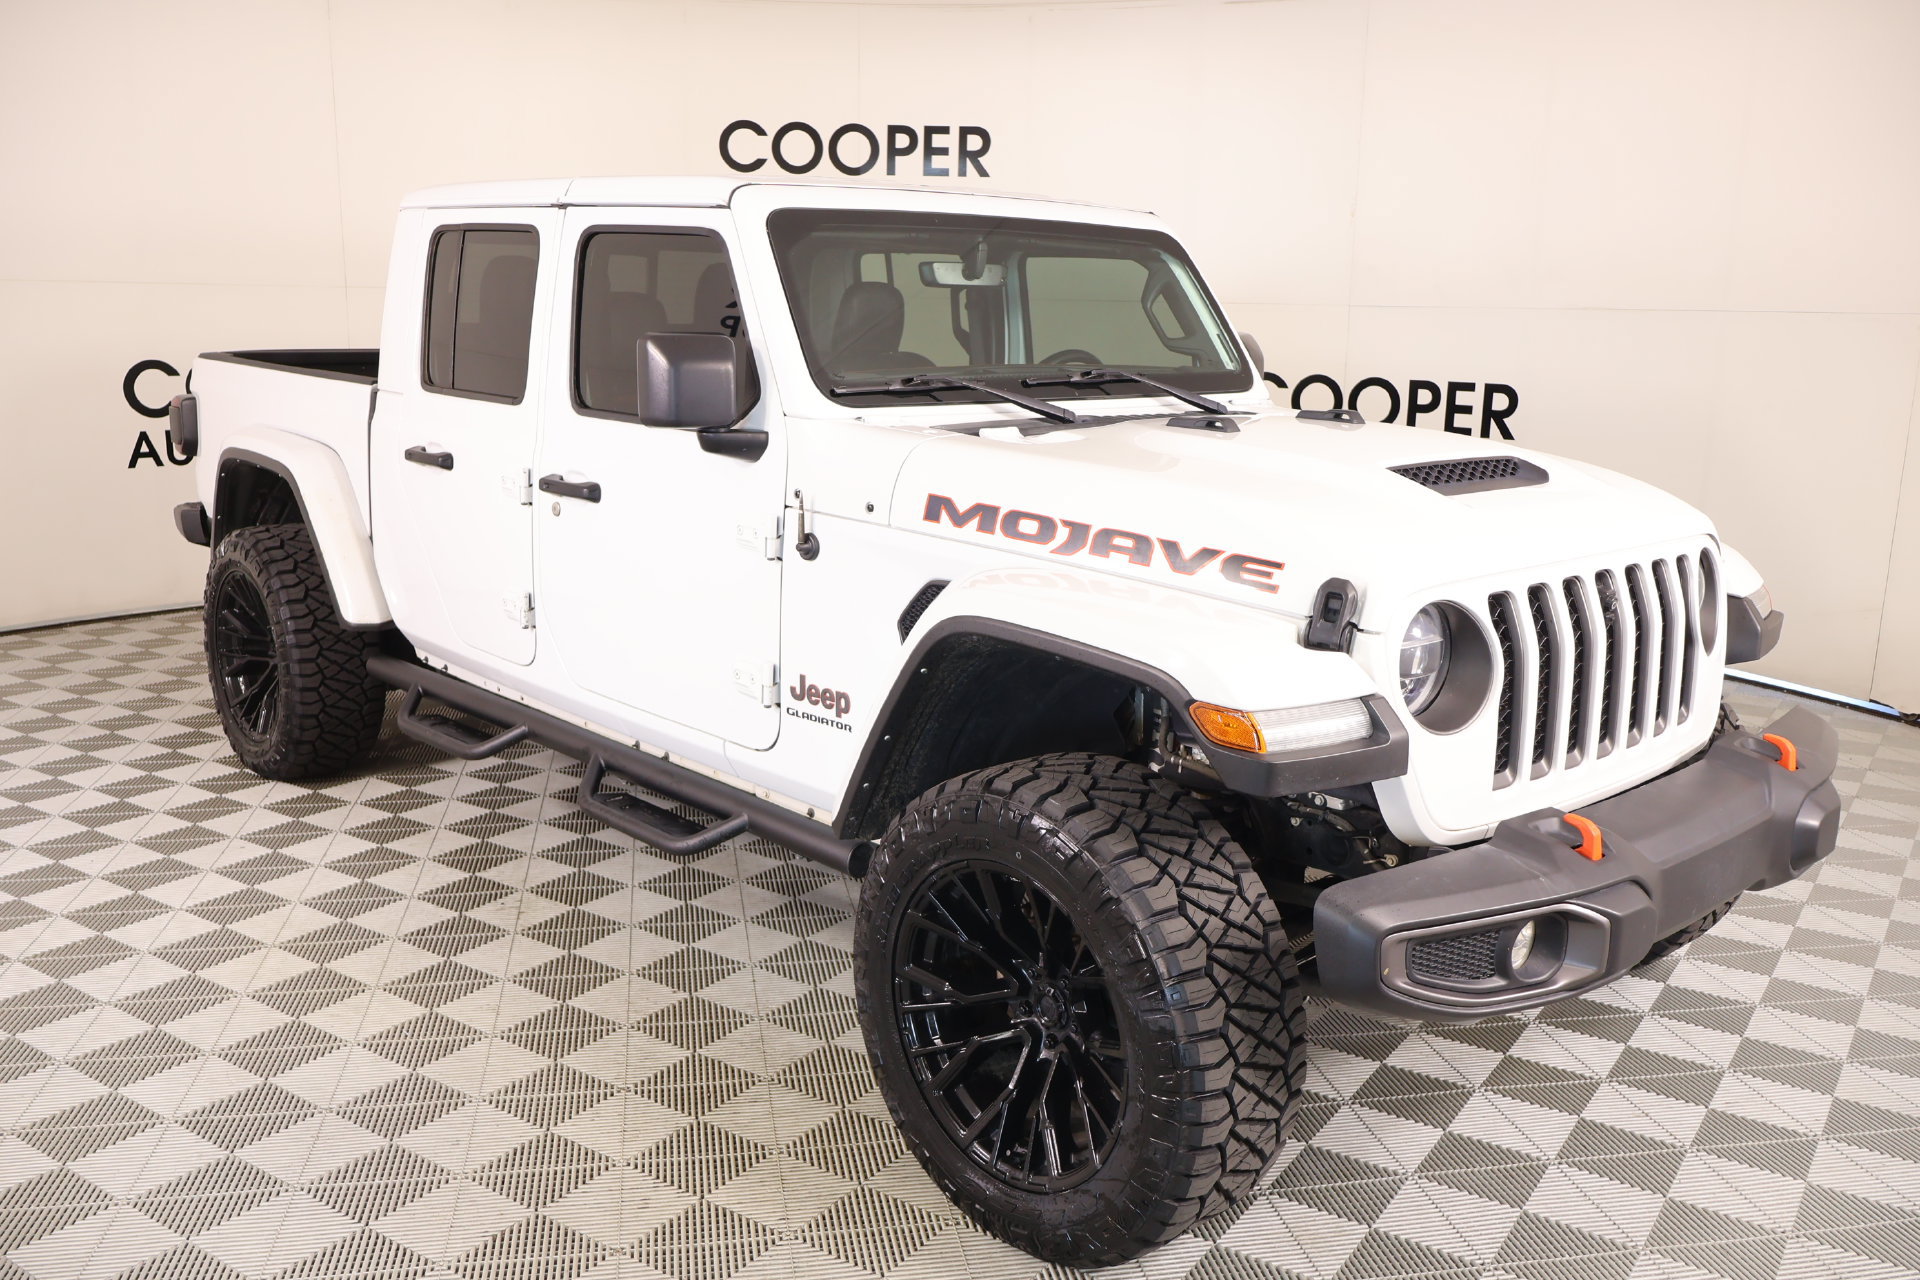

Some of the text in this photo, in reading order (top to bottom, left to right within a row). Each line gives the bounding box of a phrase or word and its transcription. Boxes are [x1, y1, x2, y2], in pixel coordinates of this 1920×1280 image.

[719, 119, 991, 178] COOPER
[922, 492, 1286, 594] MOJAVE
[786, 706, 853, 733] GLADIATOR
[789, 673, 852, 719] Jeep
